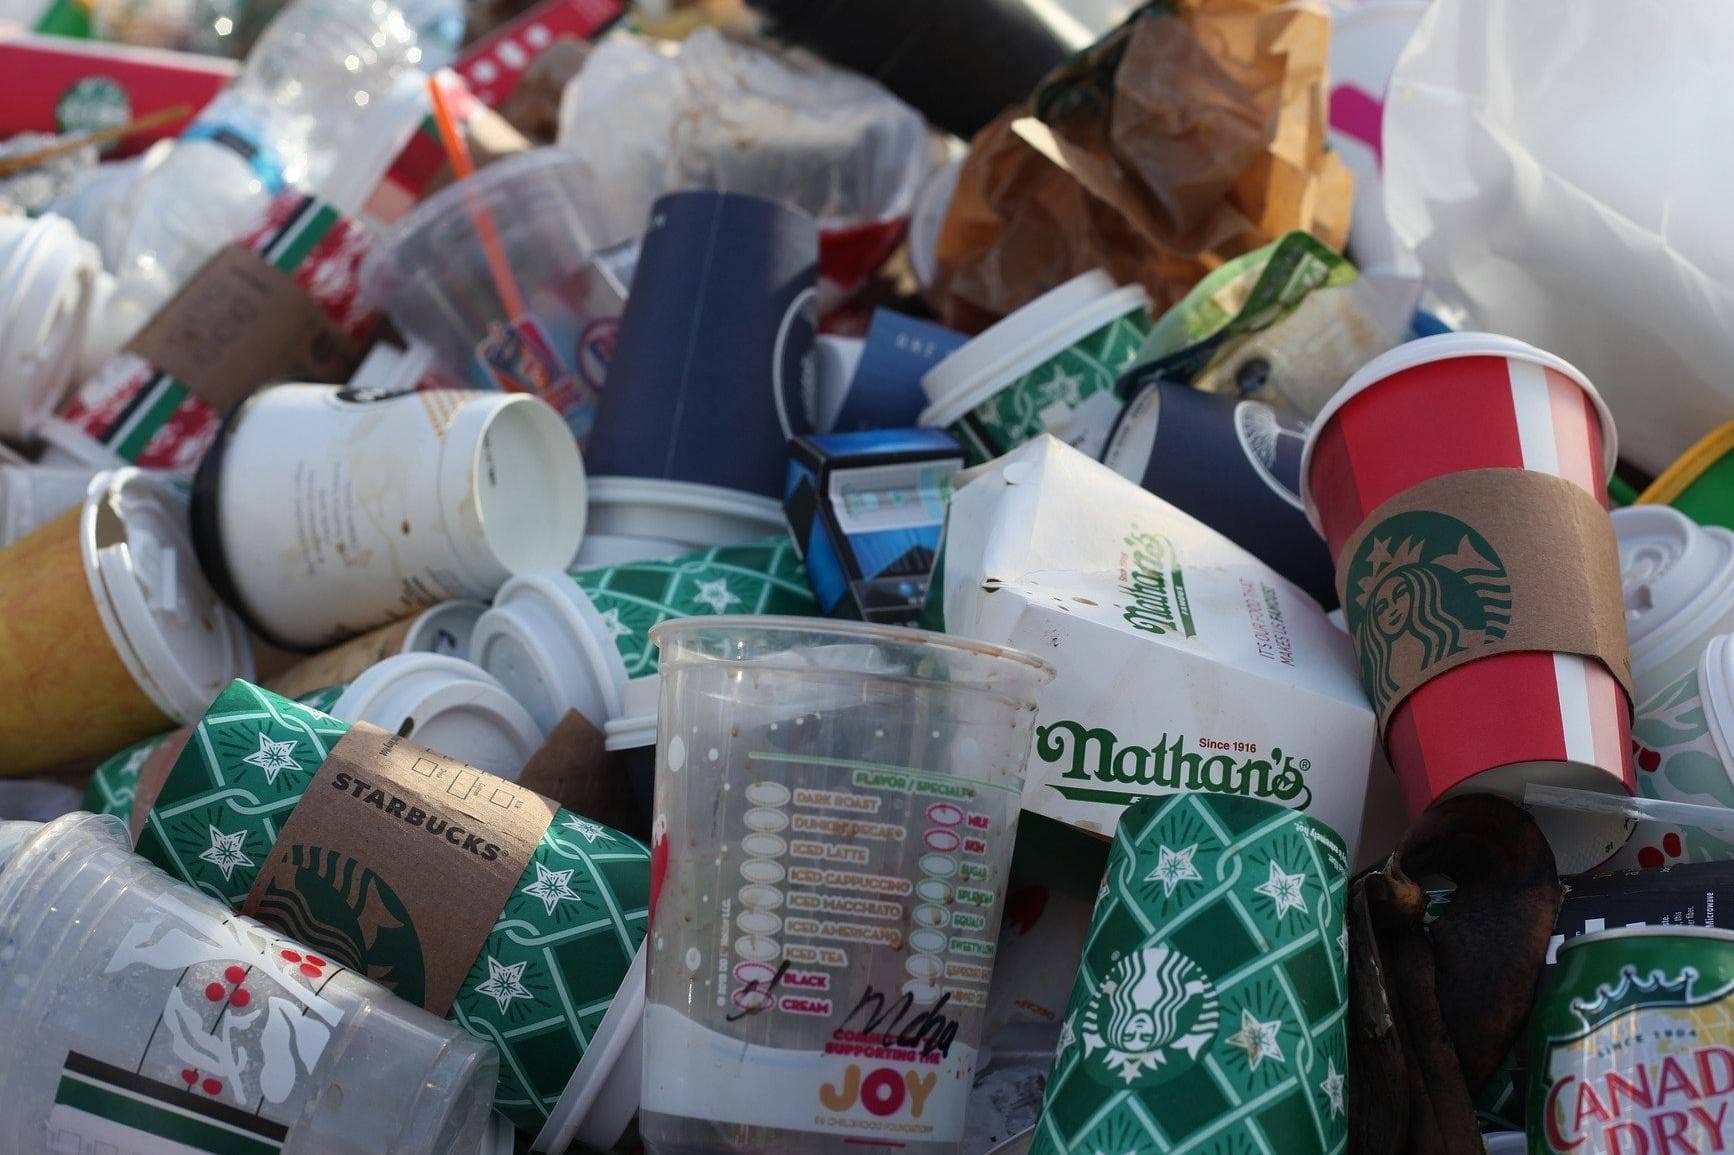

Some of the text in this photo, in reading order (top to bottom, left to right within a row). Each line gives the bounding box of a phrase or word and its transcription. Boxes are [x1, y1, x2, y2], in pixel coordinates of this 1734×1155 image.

[1199, 737, 1257, 753] Since 1916
[1036, 720, 1312, 811] Nathan's
[855, 772, 906, 789] FLAVOR
[797, 791, 879, 811] DARK ROAST
[331, 772, 501, 862] STARBUCKS
[793, 843, 867, 862] ICED LATTE
[790, 869, 912, 891] ICED CAPPUCCINO
[789, 894, 901, 917] ICED MACCHIATO
[1704, 892, 1715, 928] Microwave
[787, 920, 819, 933] ICED
[786, 947, 844, 965] ICED TEA
[783, 973, 828, 988] BLACK
[781, 999, 830, 1014] CREAM
[825, 1041, 916, 1063] SUPPORTING
[819, 1064, 938, 1119] JOY
[1602, 1101, 1729, 1155] DRY
